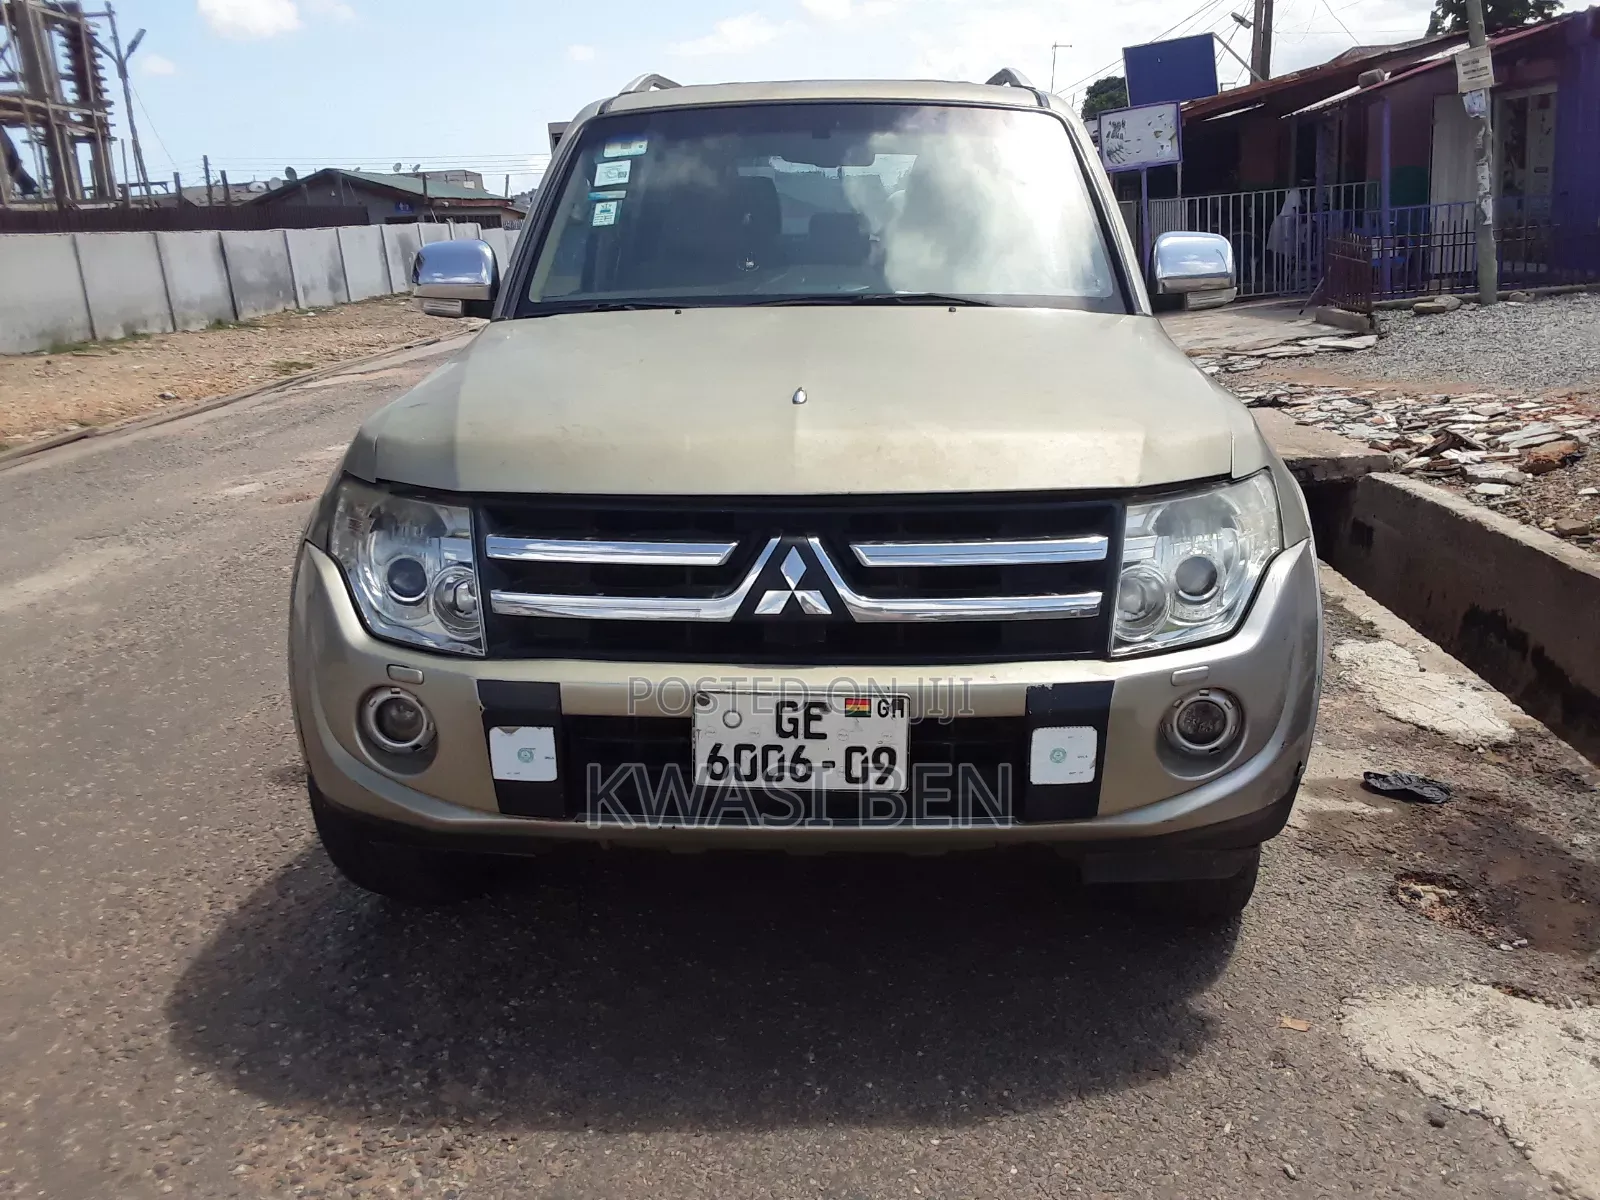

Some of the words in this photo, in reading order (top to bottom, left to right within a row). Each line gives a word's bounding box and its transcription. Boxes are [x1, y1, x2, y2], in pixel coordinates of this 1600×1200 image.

[775, 700, 829, 740] GE
[876, 698, 905, 718] GH
[706, 743, 897, 785] 6006-09
